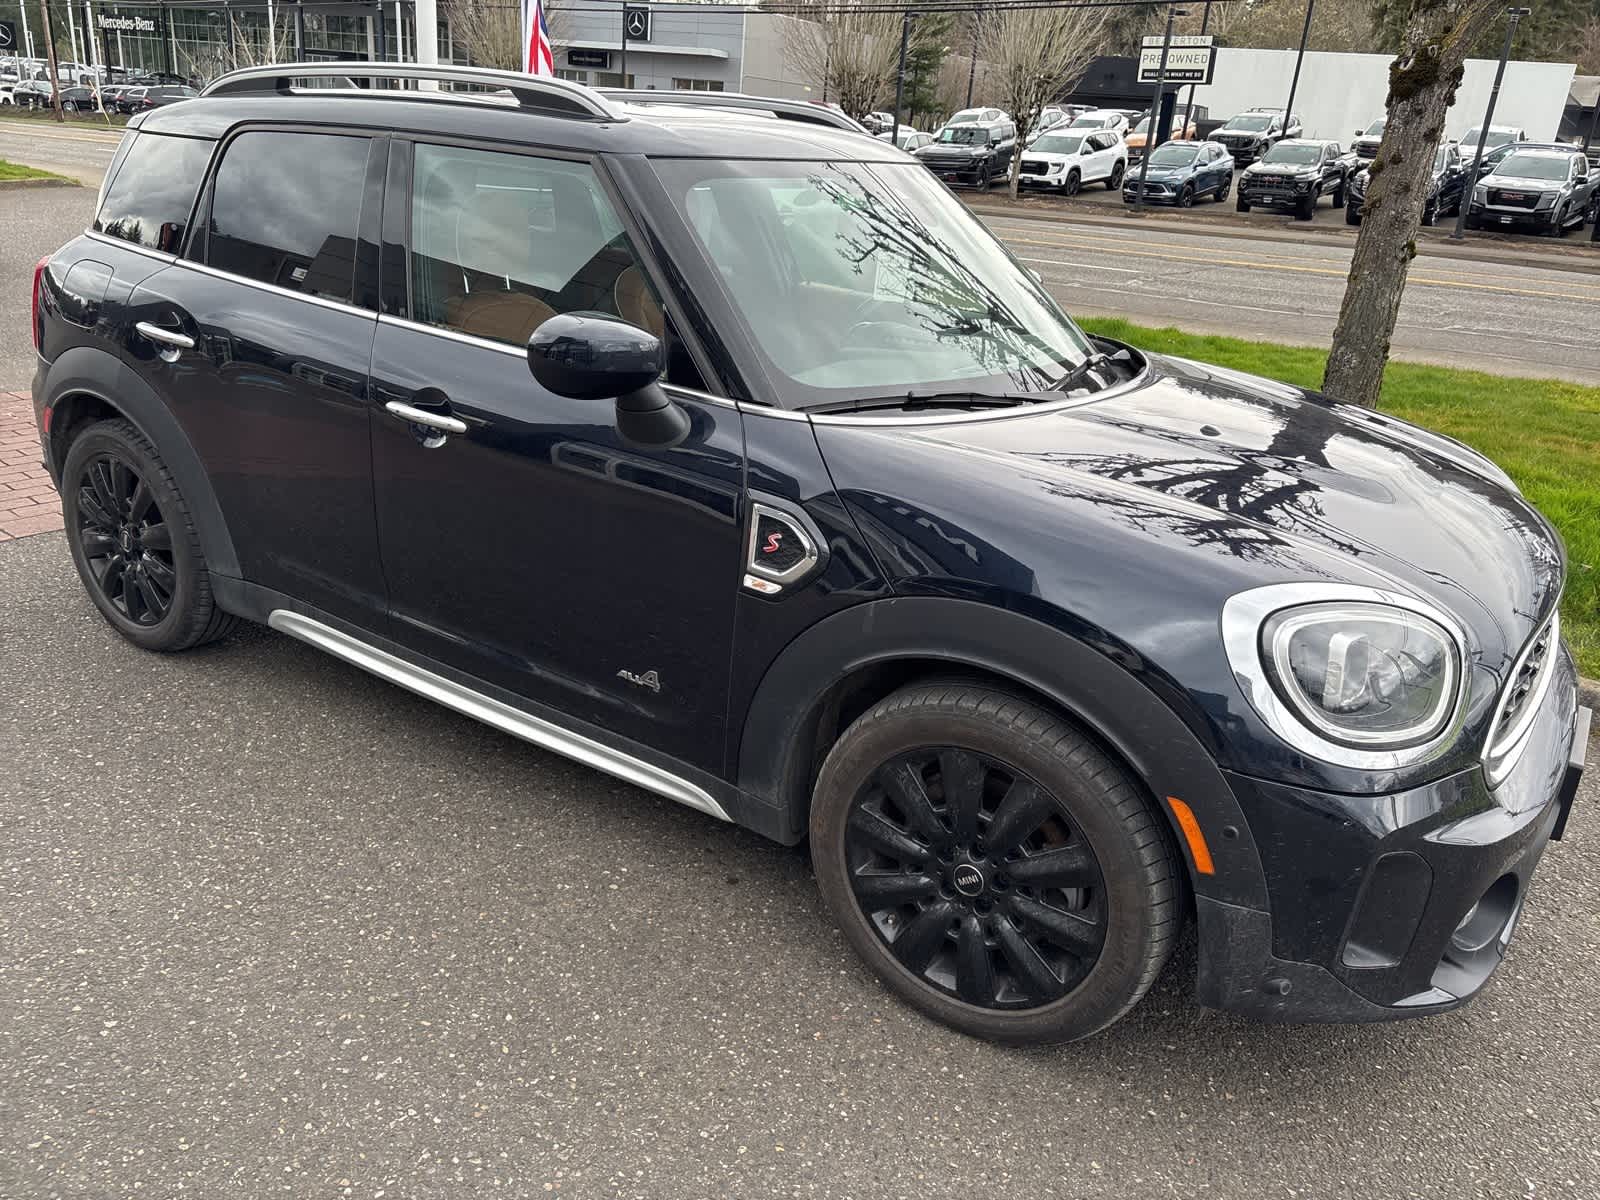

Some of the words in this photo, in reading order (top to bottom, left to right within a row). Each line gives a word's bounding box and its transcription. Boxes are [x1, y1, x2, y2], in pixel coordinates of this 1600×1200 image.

[97, 14, 155, 31] Mercedes-Benz
[1149, 37, 1207, 45] BEERTON
[1168, 54, 1208, 64] OWNED
[763, 533, 782, 553] S
[616, 670, 661, 693] ALL4
[957, 874, 979, 886] MINI
